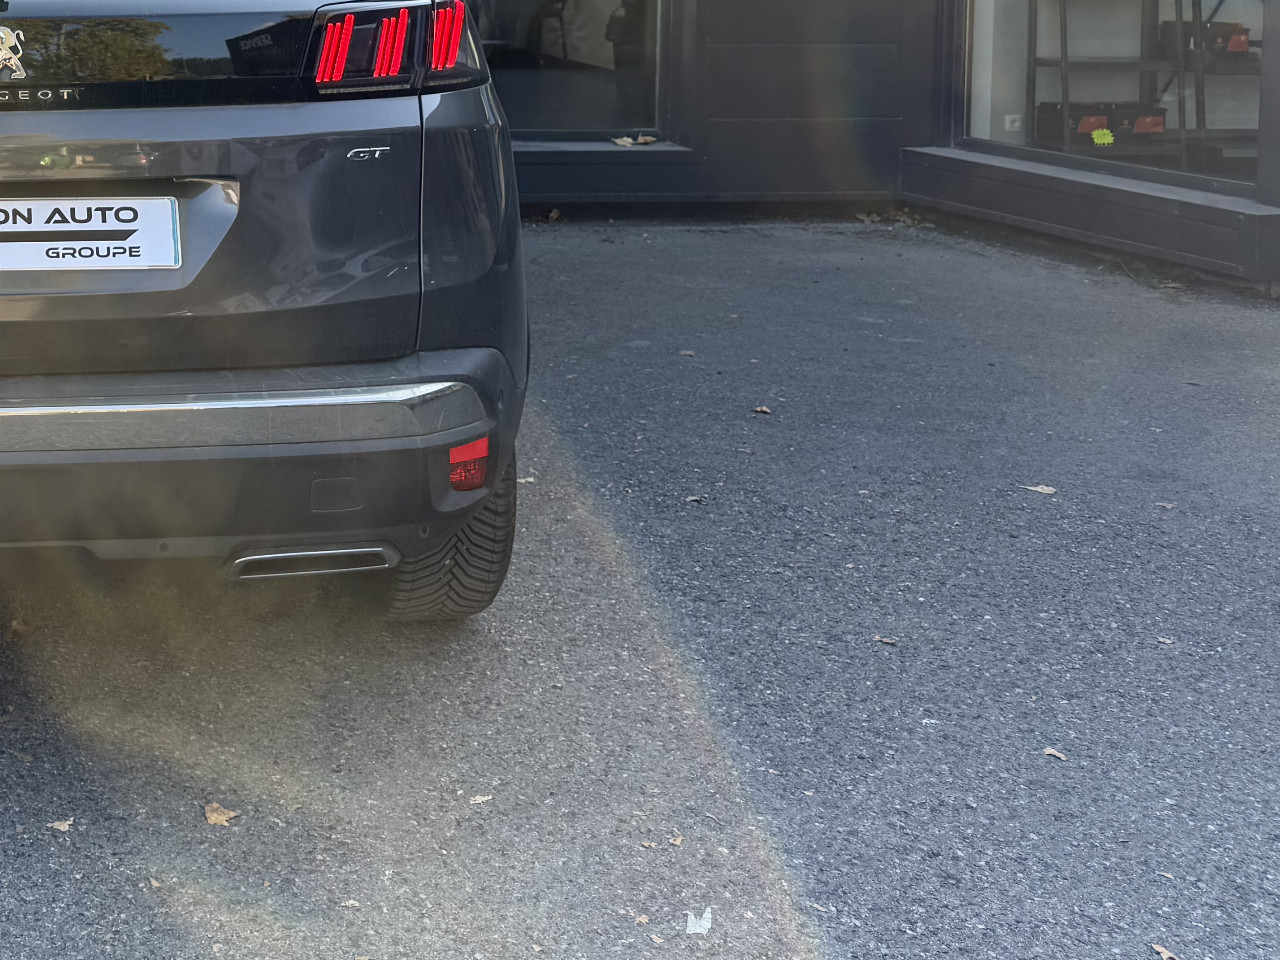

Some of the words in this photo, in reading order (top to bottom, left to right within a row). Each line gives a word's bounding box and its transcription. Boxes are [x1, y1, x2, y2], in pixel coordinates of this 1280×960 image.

[346, 146, 391, 161] GT
[43, 206, 139, 225] AUTO
[45, 245, 142, 260] GROUPE
